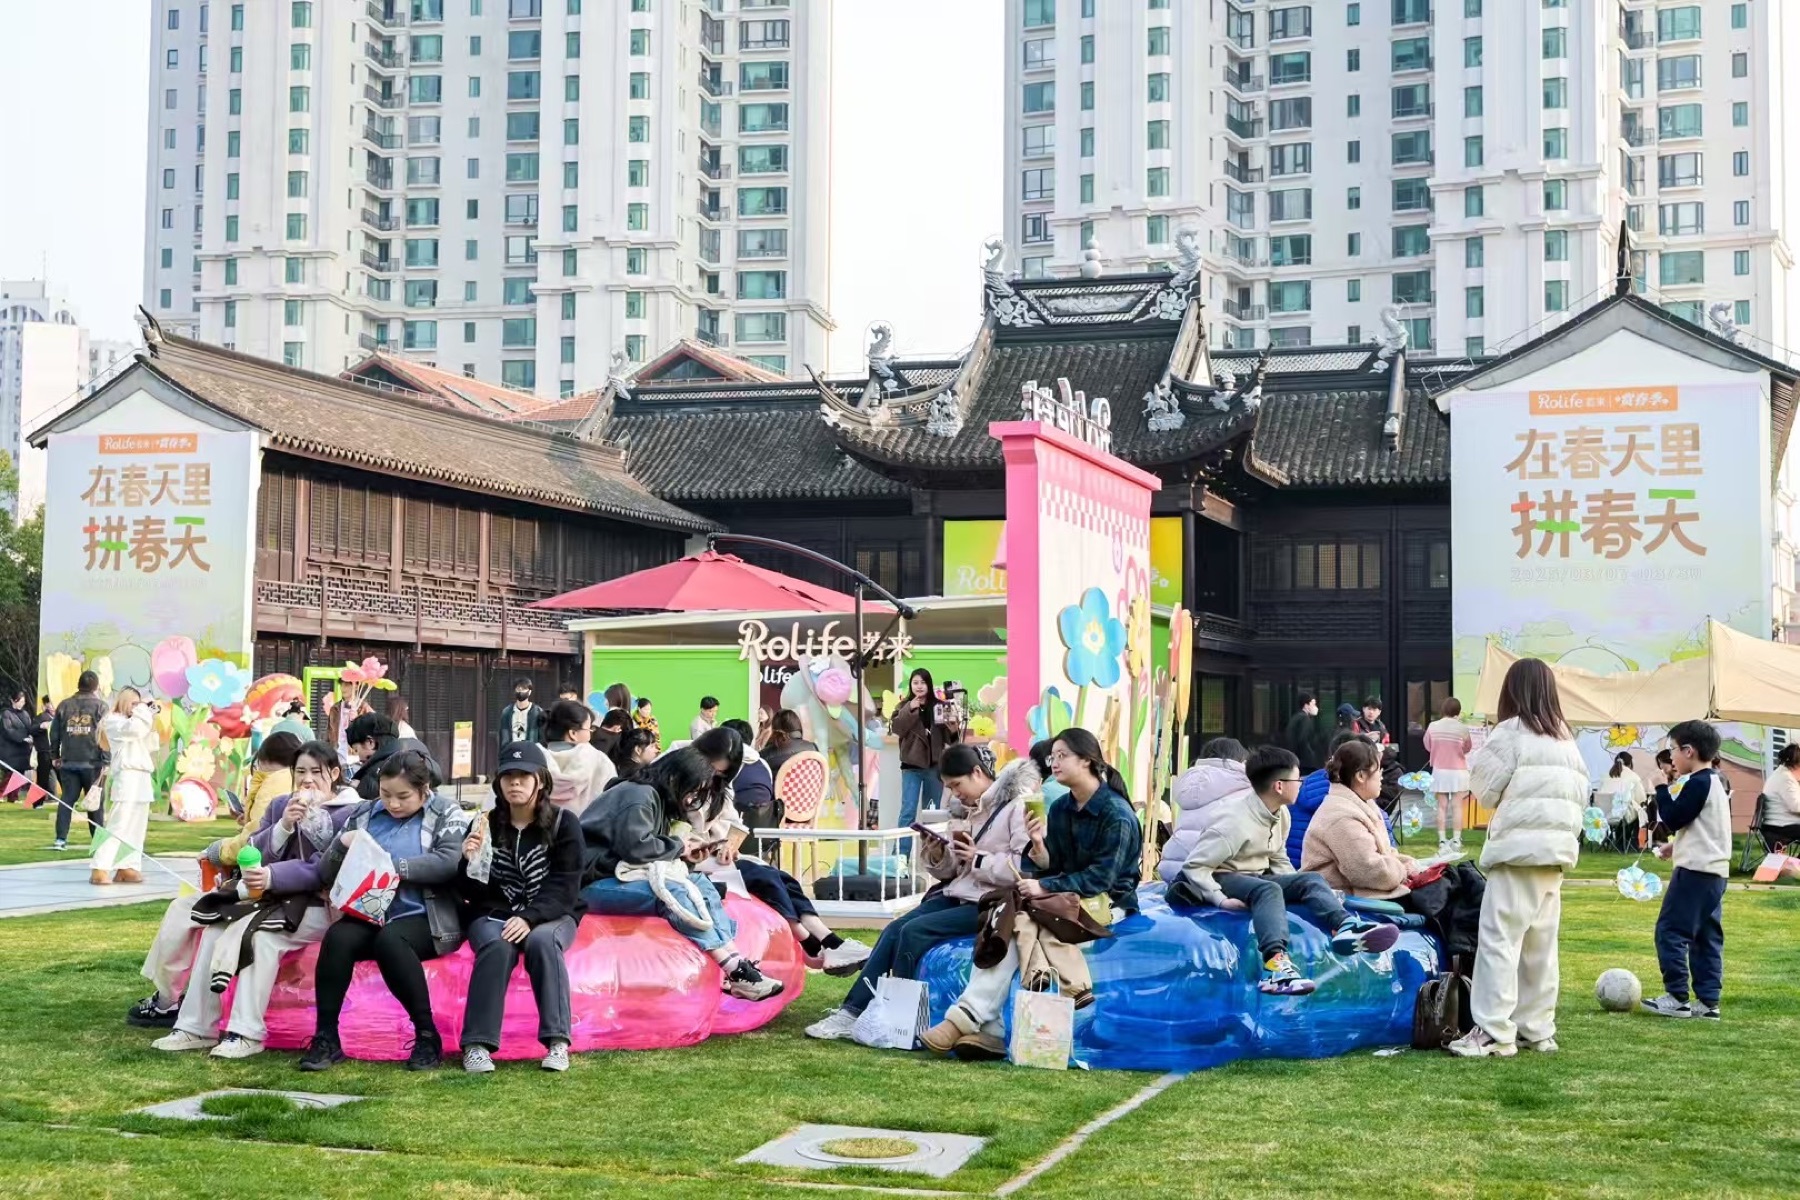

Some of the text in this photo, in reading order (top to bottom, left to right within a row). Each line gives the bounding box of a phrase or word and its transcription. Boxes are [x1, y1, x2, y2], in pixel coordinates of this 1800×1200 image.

[1538, 392, 1583, 410] Rolife
[1503, 422, 1704, 480] 在春天里
[80, 463, 211, 507] 在春天里
[83, 516, 210, 573] 拼春天
[1511, 489, 1707, 560] 拼春天
[738, 620, 857, 662] Rolife
[760, 665, 792, 684] life
